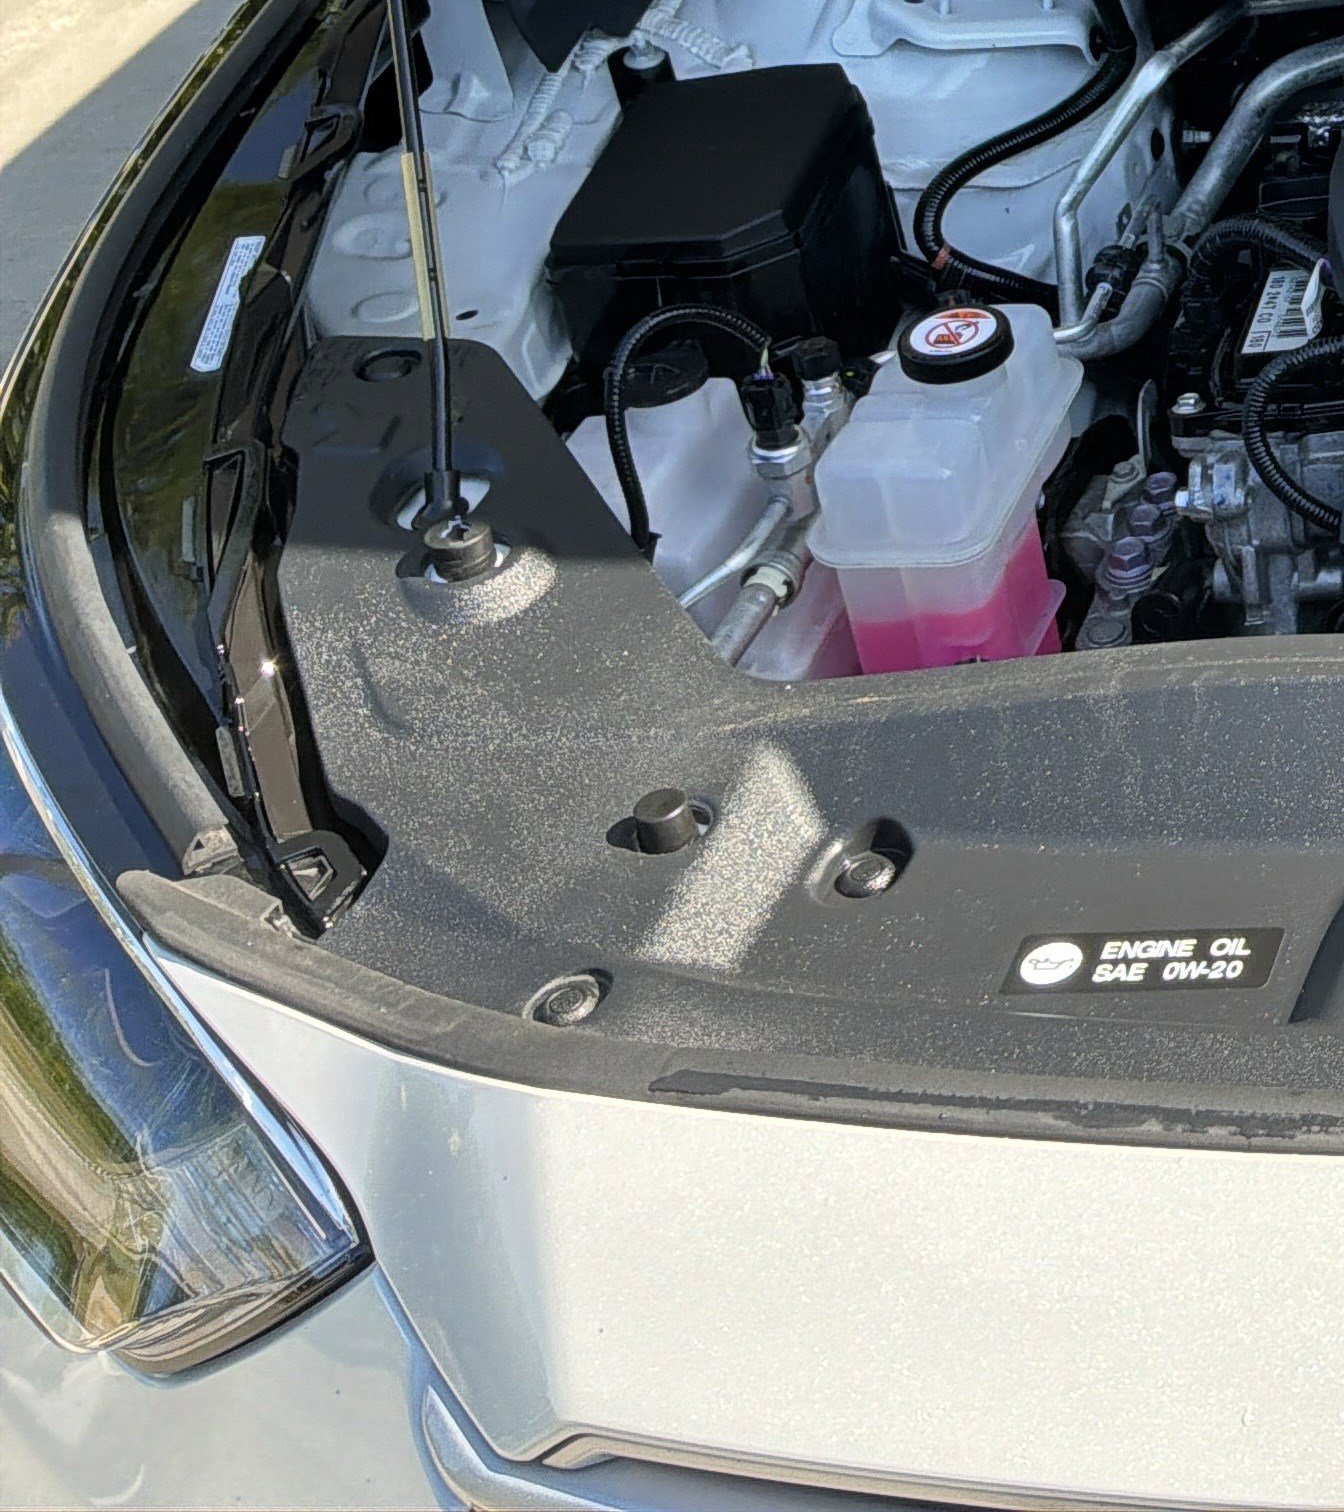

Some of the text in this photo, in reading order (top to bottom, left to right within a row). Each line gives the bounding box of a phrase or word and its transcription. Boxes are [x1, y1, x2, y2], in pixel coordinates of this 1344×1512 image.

[1100, 937, 1251, 959] ENGINE OIL
[1092, 960, 1244, 982] SAE 0W-20
